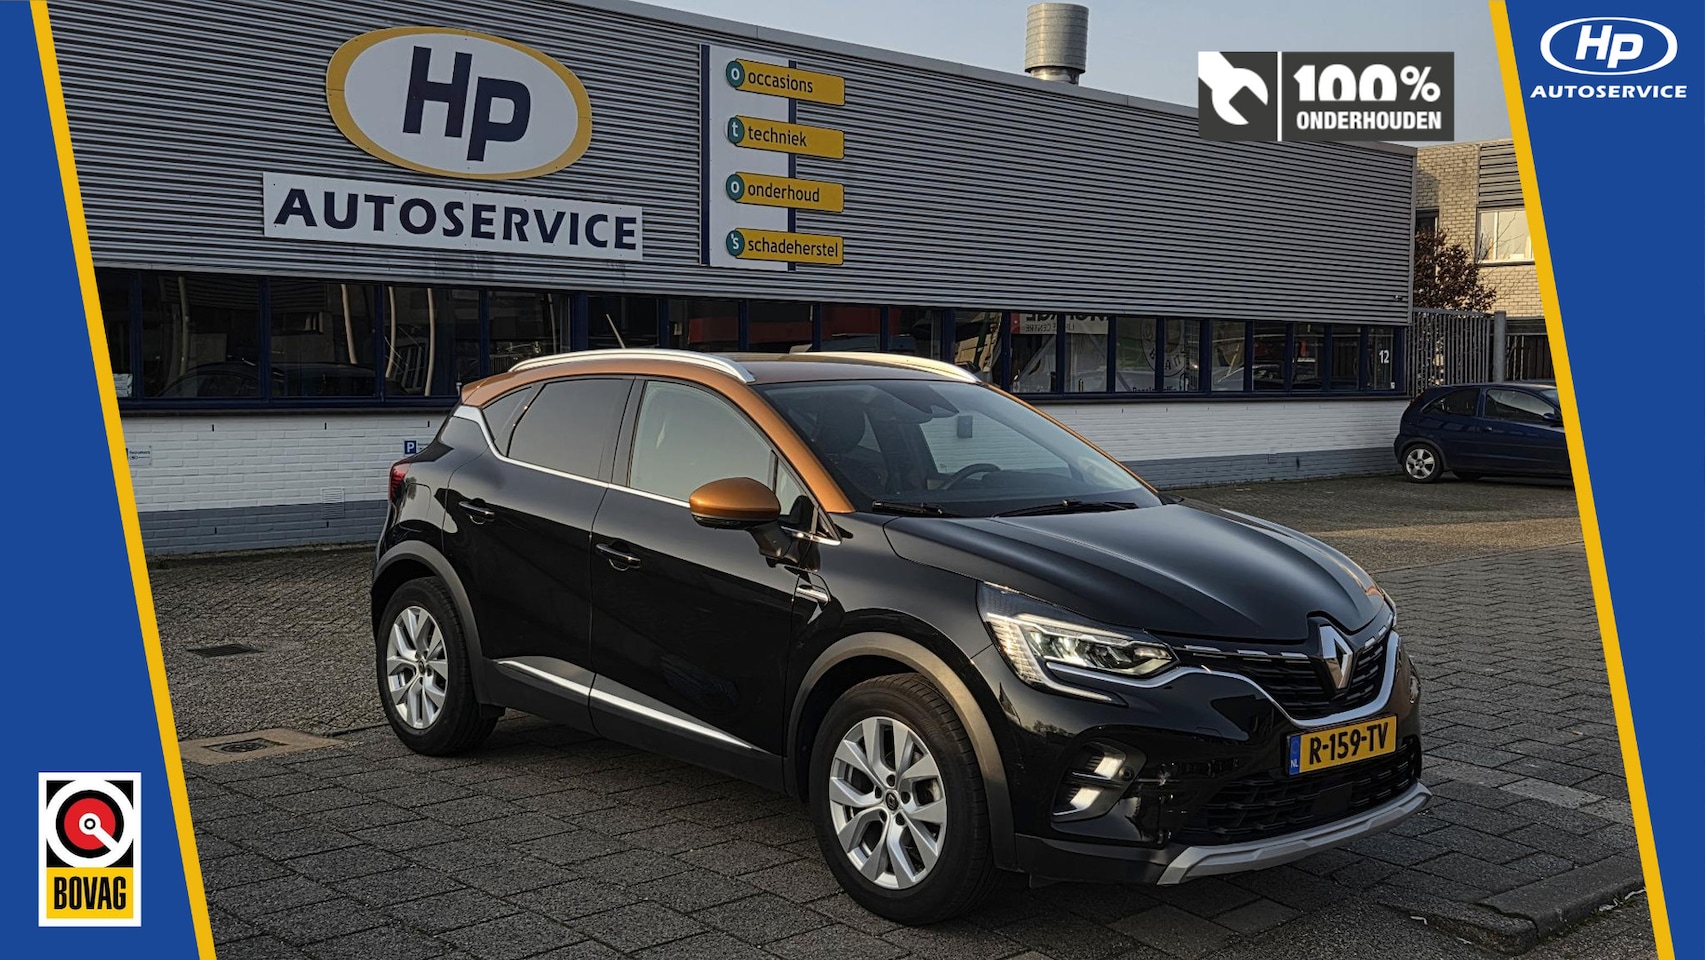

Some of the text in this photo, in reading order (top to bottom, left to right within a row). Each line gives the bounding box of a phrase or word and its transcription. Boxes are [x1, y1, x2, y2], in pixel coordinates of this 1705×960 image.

[748, 71, 813, 93] occasions
[748, 126, 807, 148] techniek
[748, 182, 820, 203] onderhoud
[274, 188, 637, 250] AUTOSERVICE
[748, 237, 838, 258] schadeherstel
[1379, 349, 1390, 364] 12
[406, 441, 415, 453] P
[1309, 721, 1389, 765] R-159-TV
[1290, 759, 1299, 768] NL
